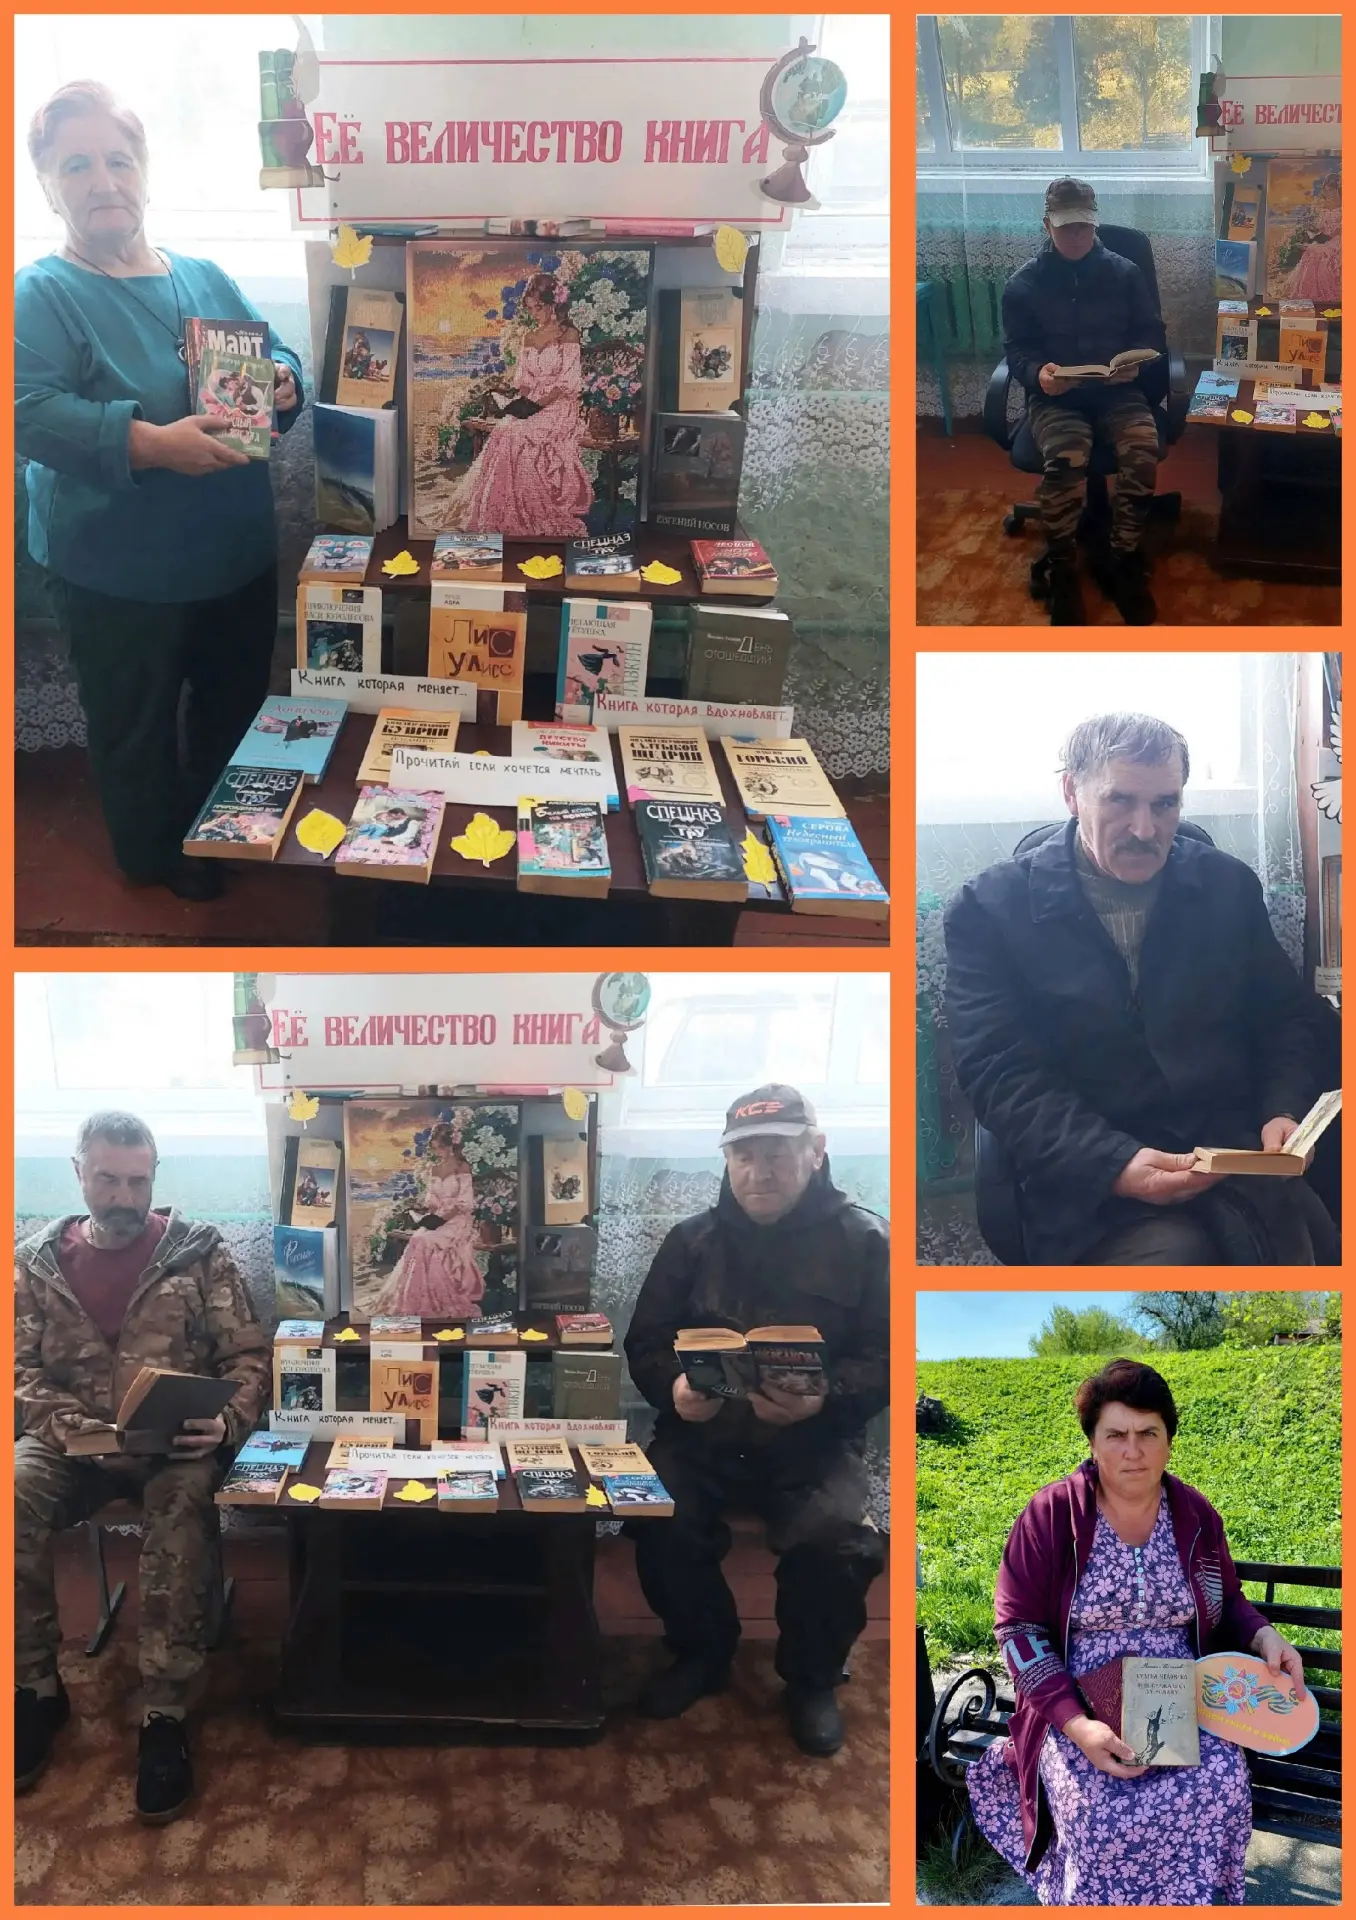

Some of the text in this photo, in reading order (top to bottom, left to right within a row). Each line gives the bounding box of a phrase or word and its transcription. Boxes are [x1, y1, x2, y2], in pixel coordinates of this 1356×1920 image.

[1221, 100, 1245, 125] ЕЁ
[313, 111, 769, 166] ЕЁ ВЕЛИЧЕСТВО КНИГА
[656, 514, 697, 529] ЕВГЕНИЙ
[573, 532, 631, 549] СПЕЦНАЗ
[298, 671, 346, 687] Книга
[358, 679, 405, 694] которая
[597, 693, 638, 712] Книга
[646, 703, 698, 718] которая
[382, 725, 449, 736] КУПРИН
[736, 754, 809, 765] ГОРЬКИЙ
[225, 772, 298, 791] СПЕЦНАЗ
[647, 805, 722, 823] СПЕЦНАЗ
[802, 823, 849, 832] СЕРОВА
[272, 1009, 601, 1047] ЕЁ ВЕЛИЧЕСТВО КНИГА
